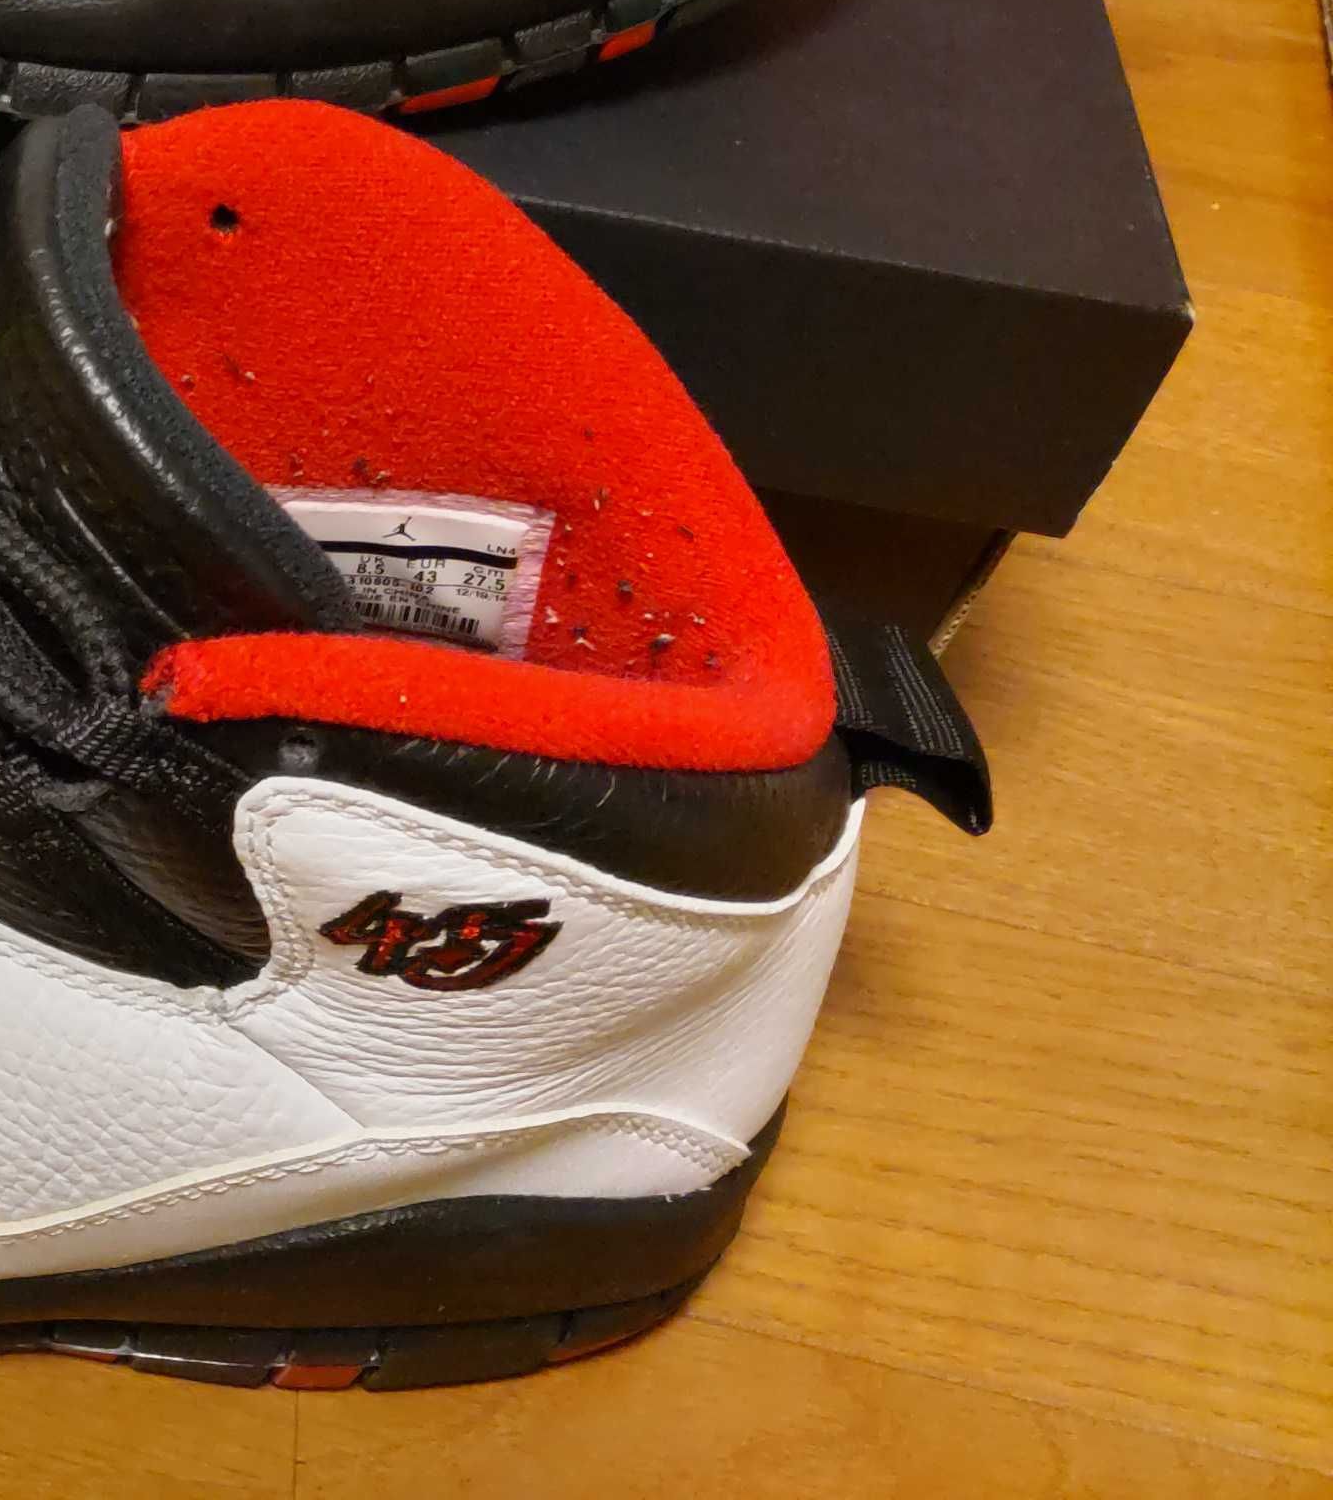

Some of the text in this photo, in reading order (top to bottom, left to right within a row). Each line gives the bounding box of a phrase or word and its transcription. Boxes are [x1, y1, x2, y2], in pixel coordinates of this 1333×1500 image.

[486, 544, 516, 556] LN4
[357, 563, 385, 575] 8.5
[414, 570, 438, 583] 43
[463, 572, 505, 591] 27.5
